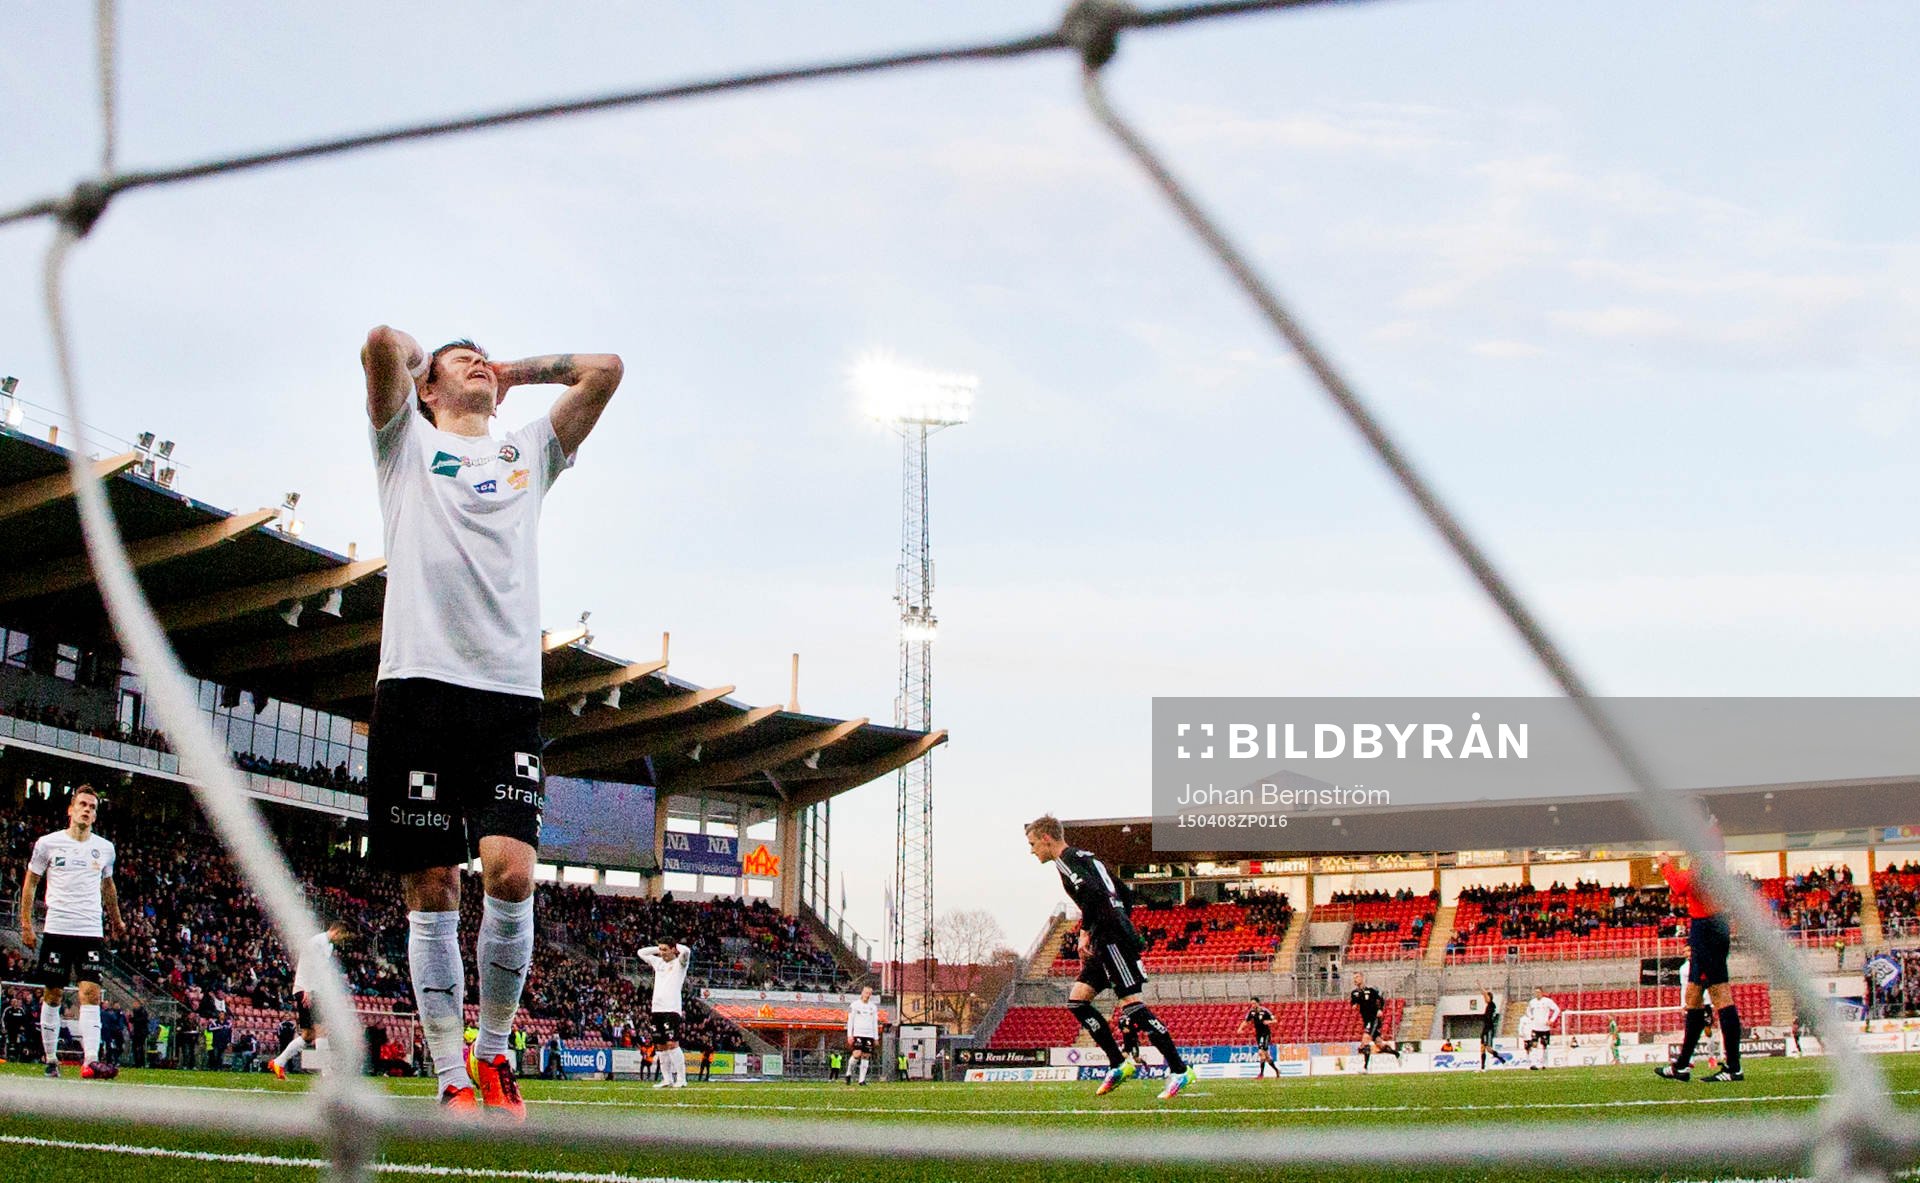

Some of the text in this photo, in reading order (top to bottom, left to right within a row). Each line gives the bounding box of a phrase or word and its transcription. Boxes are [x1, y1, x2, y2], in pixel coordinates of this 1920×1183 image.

[494, 783, 545, 810] Strate
[666, 833, 731, 854] NA NA
[743, 844, 780, 877] MAX
[1180, 1053, 1210, 1064] PMG
[985, 1068, 1070, 1081] TIPS ELIT
